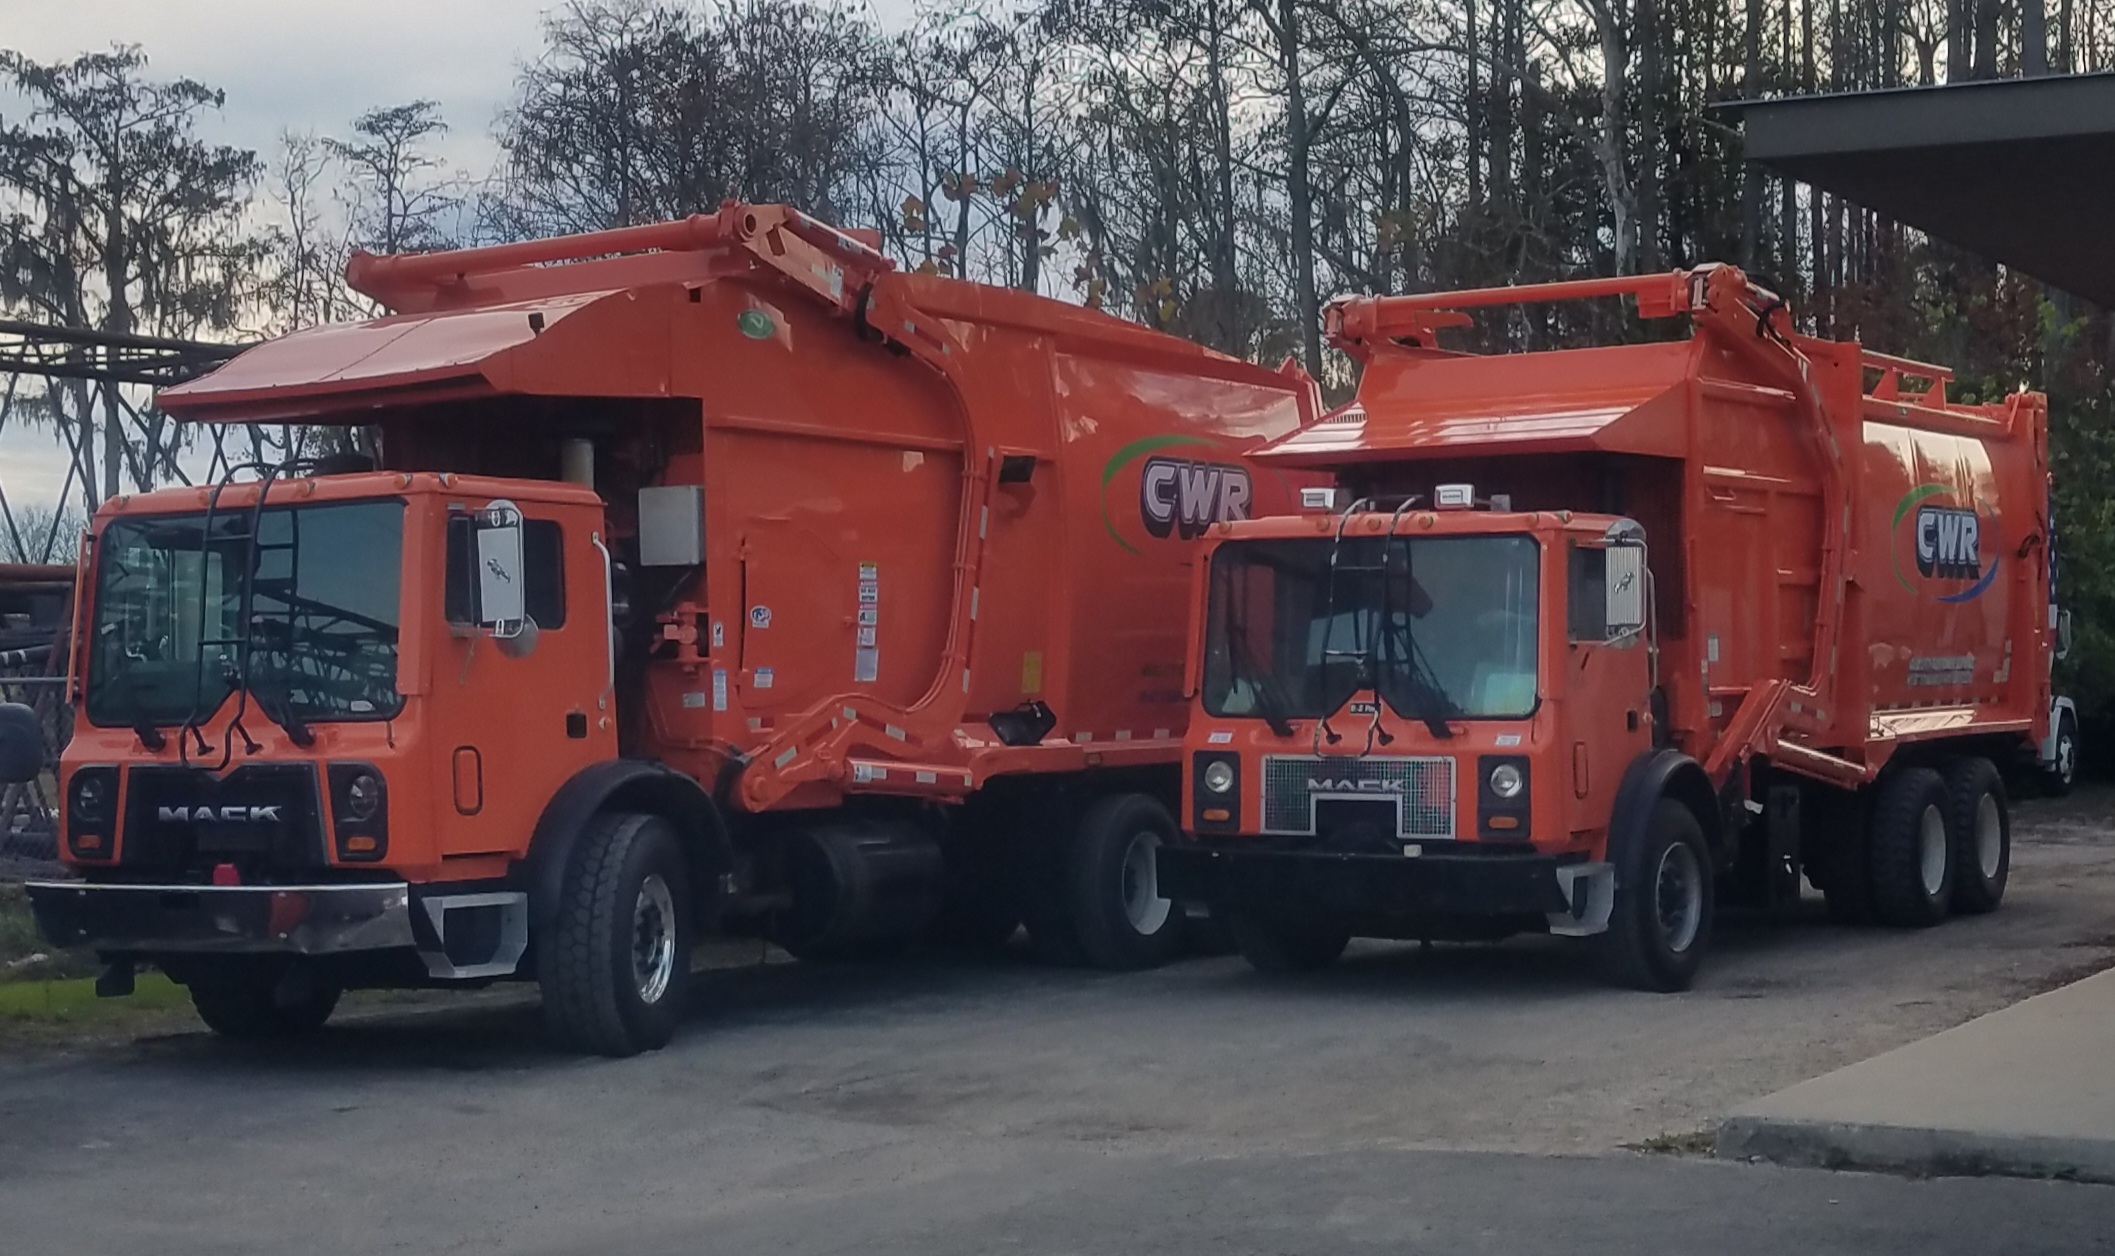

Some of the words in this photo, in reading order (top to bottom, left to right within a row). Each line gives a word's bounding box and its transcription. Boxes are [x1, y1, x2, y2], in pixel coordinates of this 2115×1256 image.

[1142, 459, 1251, 531] CWR
[1917, 507, 1979, 571] CWR
[1308, 778, 1404, 791] MACK
[158, 806, 281, 821] MACK
